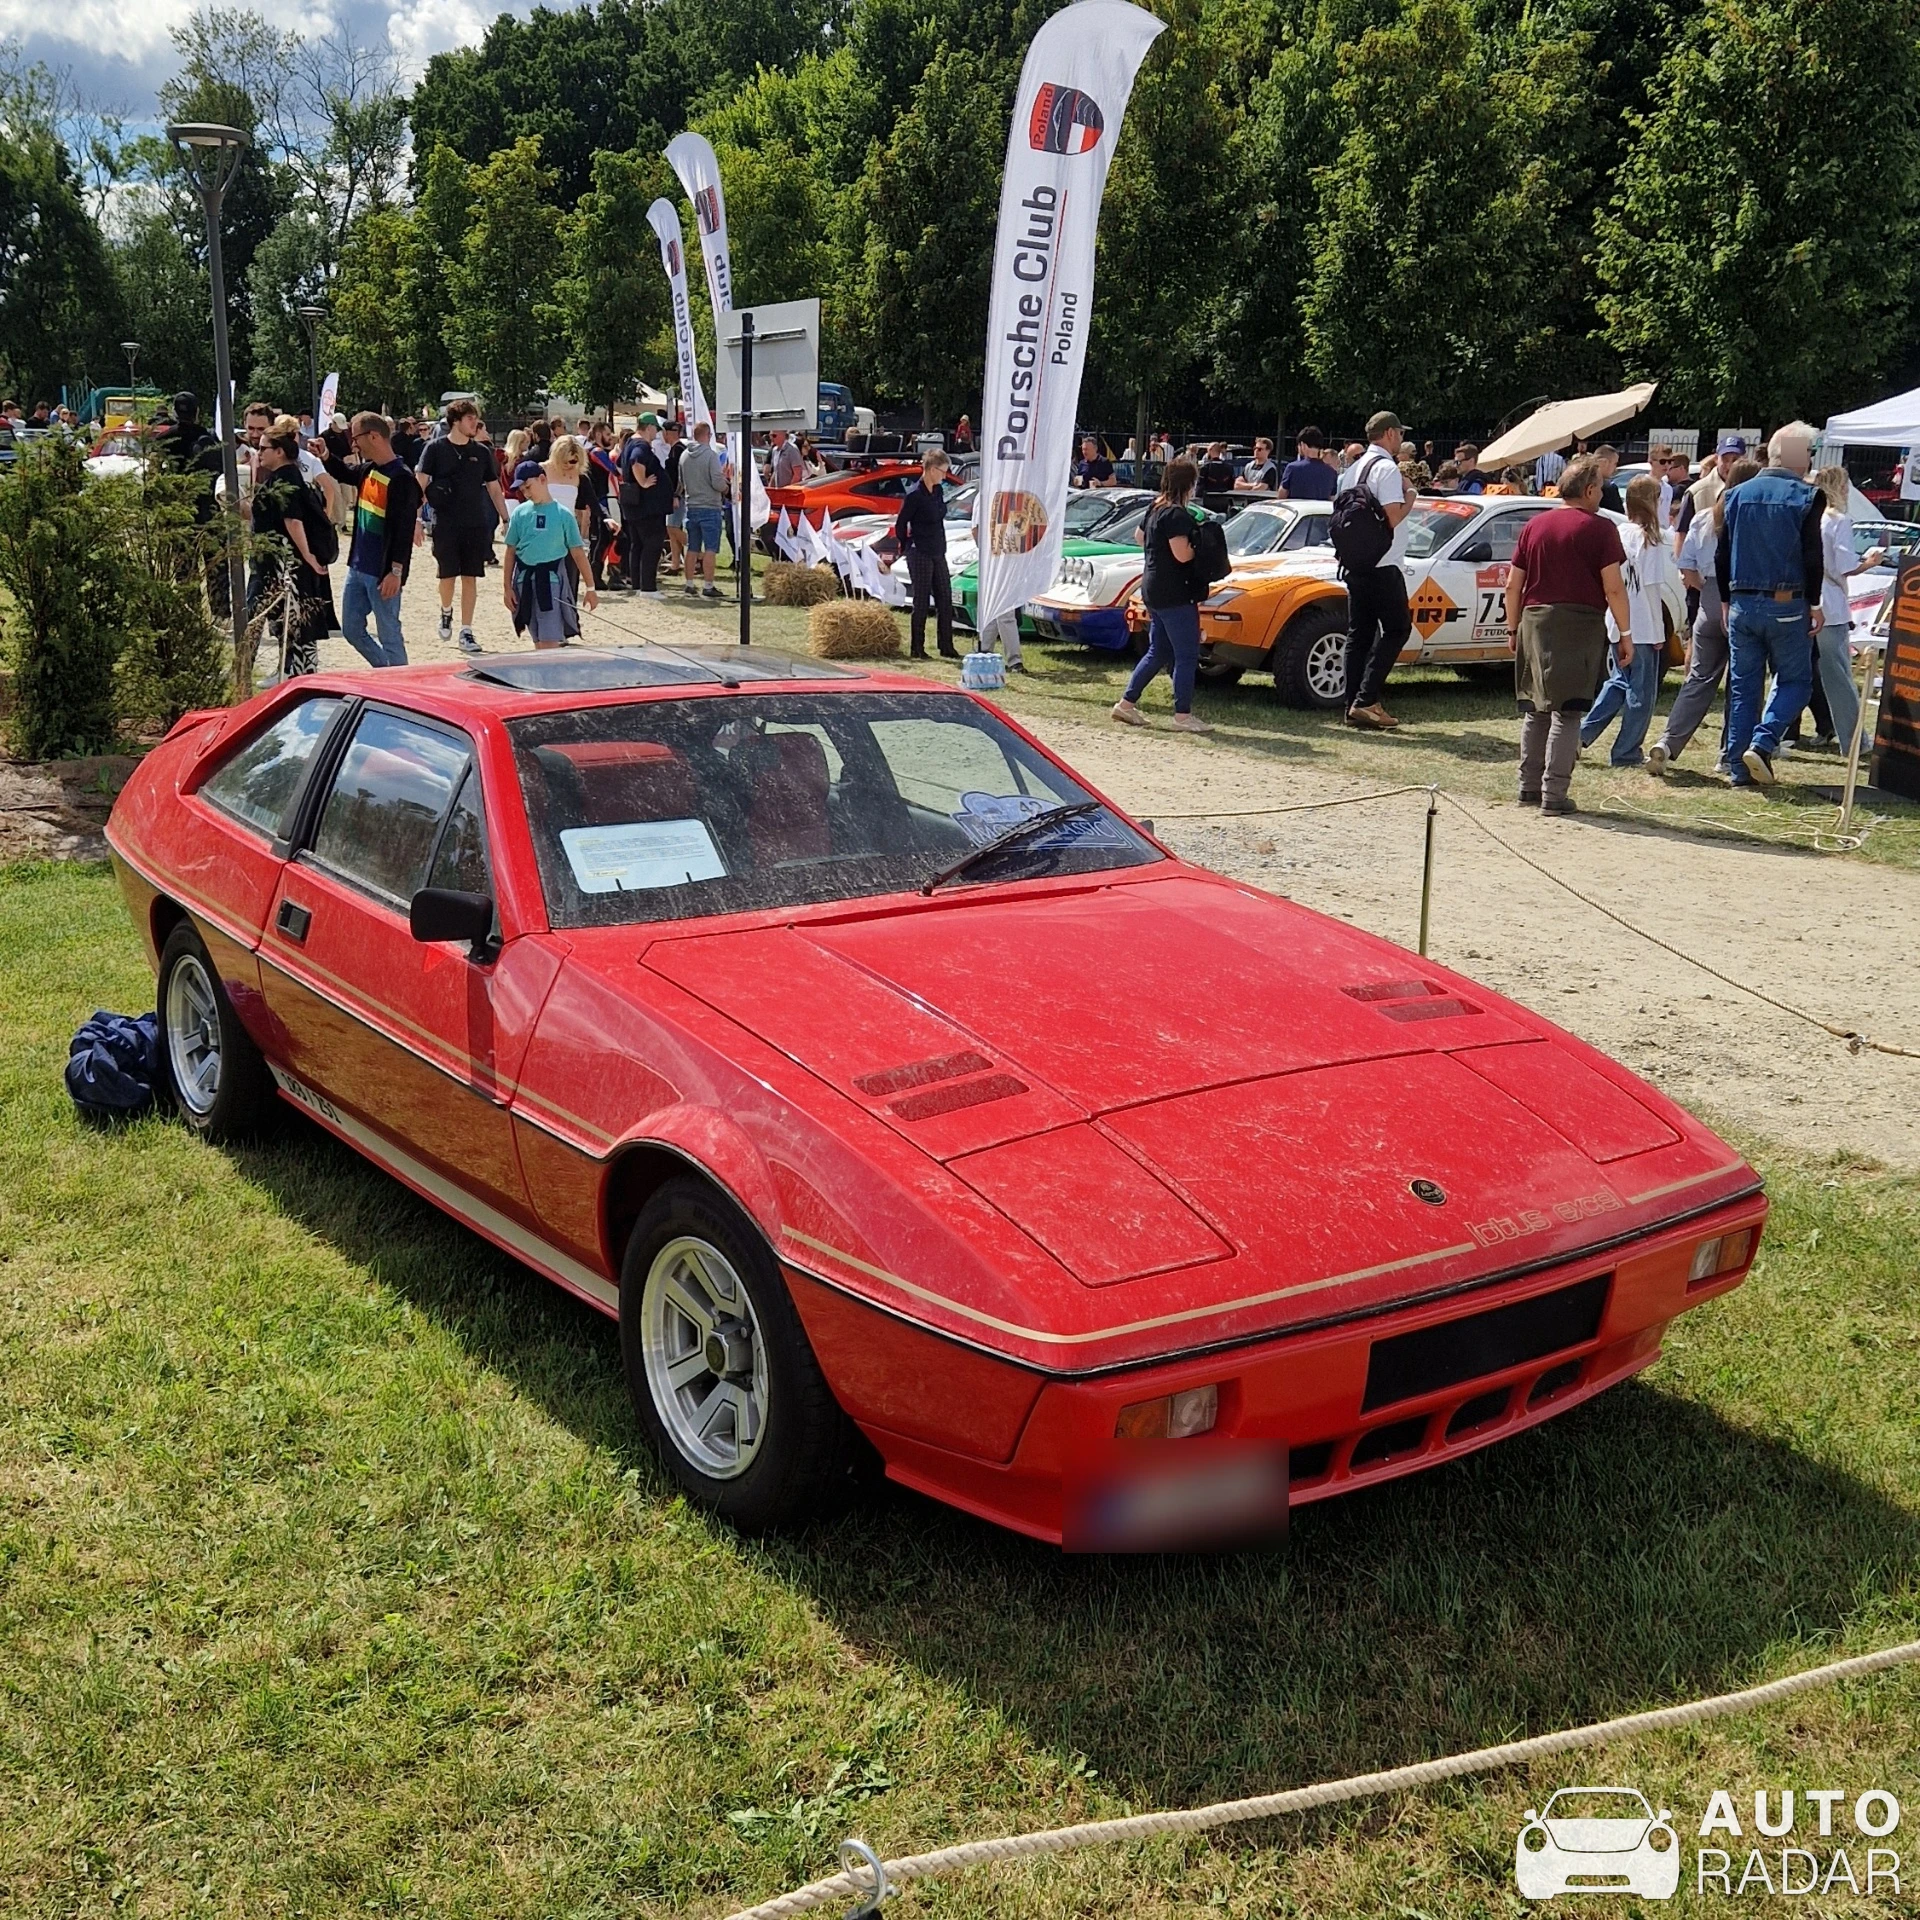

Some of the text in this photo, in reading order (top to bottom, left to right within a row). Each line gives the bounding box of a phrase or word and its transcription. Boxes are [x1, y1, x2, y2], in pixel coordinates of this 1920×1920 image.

[1032, 87, 1053, 145] Poland
[997, 185, 1057, 461] Porsche Club
[1051, 292, 1078, 365] Poland
[1484, 628, 1508, 636] TUDO
[1464, 1184, 1626, 1248] lotus excel
